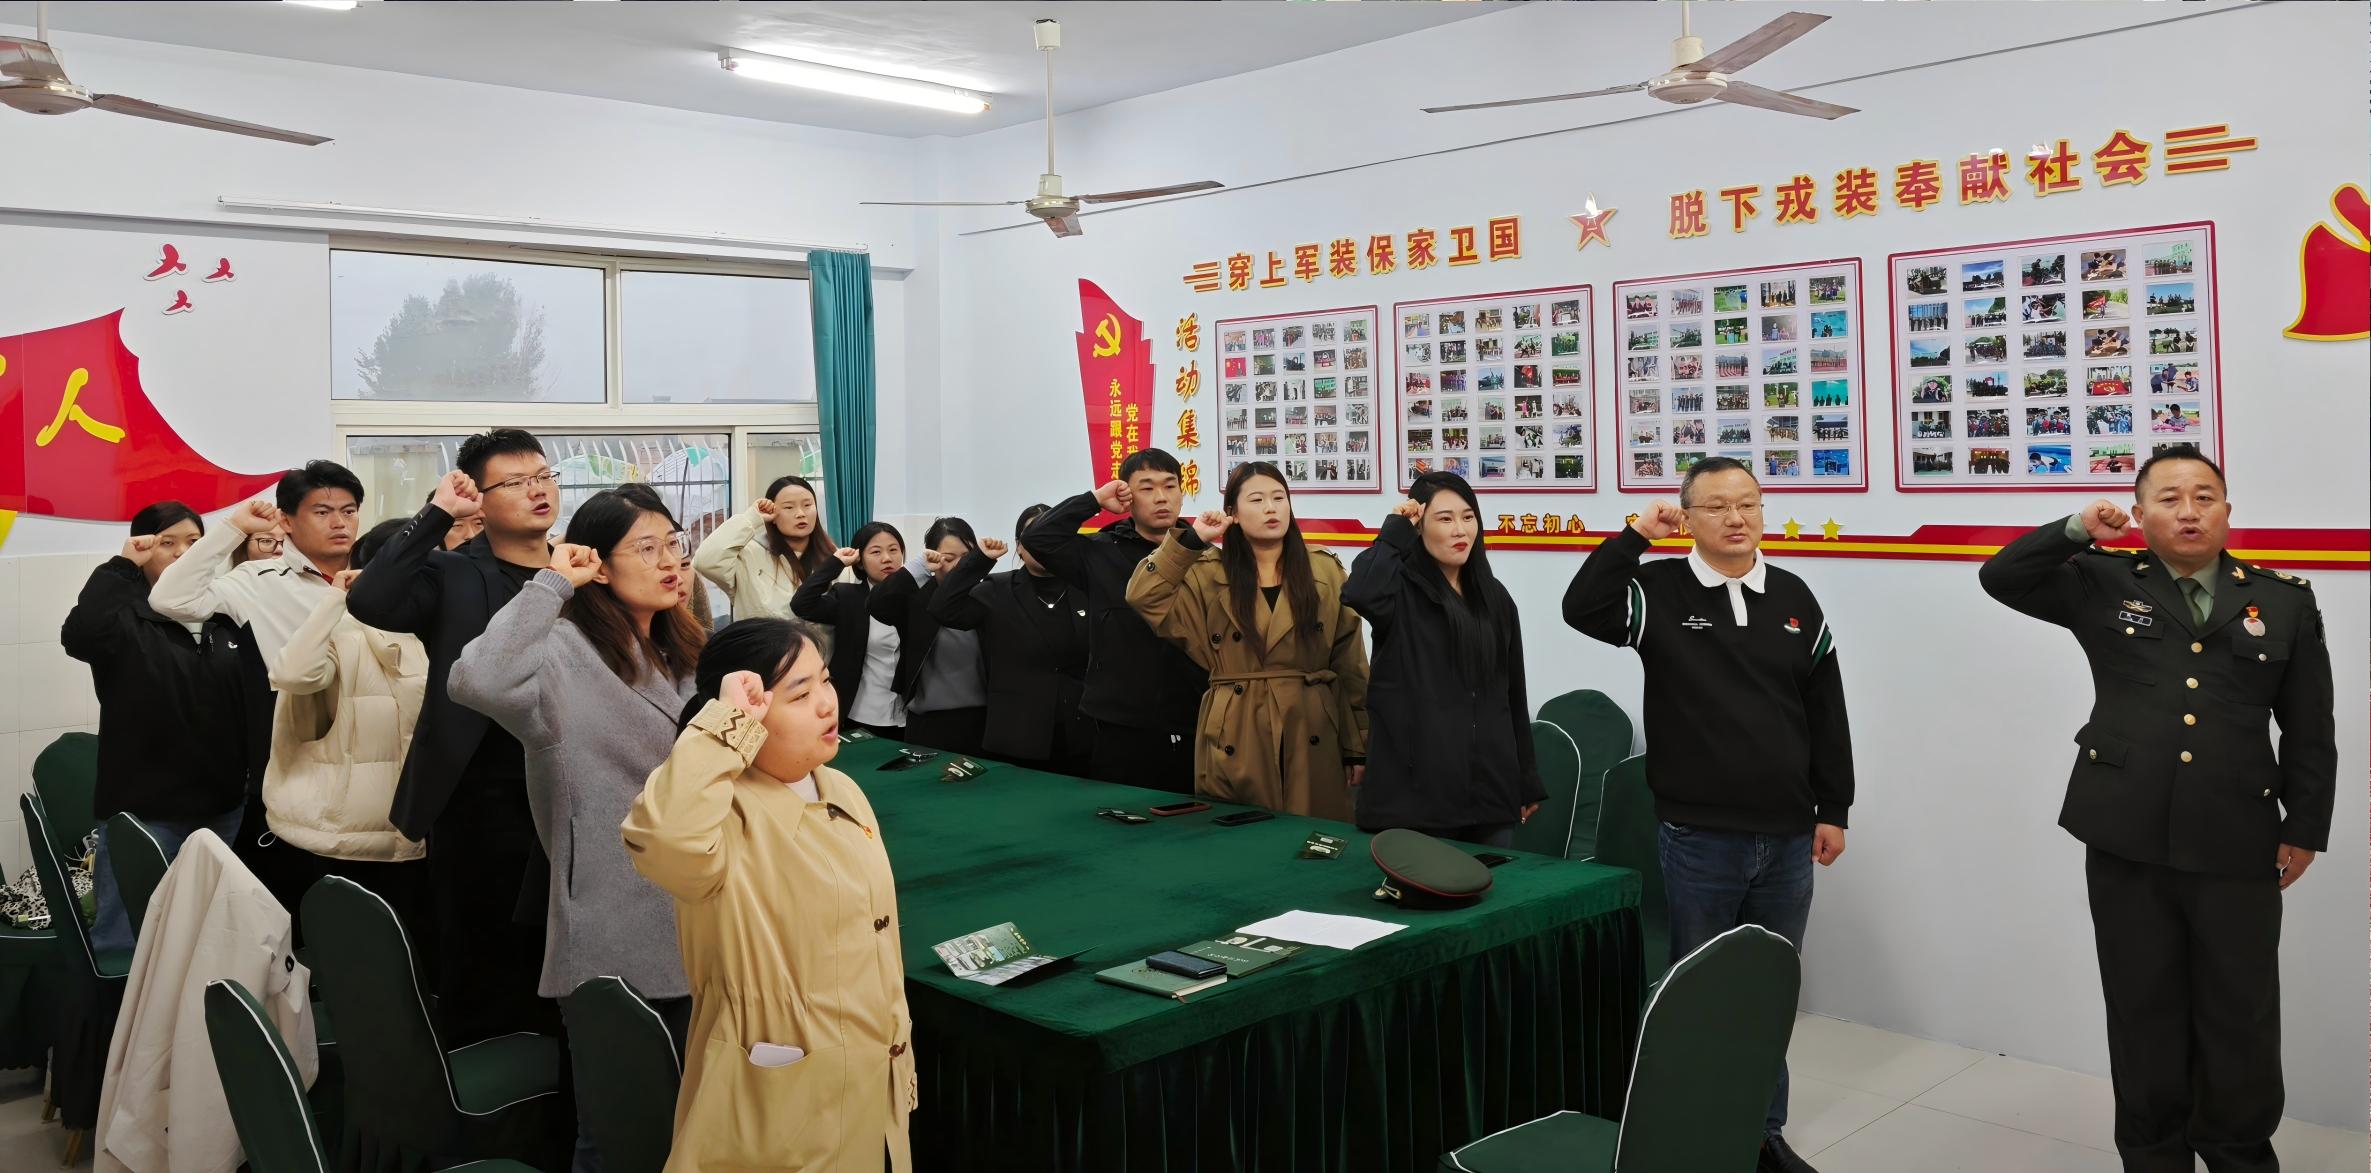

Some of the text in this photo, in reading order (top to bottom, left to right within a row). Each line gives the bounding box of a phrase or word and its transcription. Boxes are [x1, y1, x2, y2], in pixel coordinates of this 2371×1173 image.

[1667, 130, 2152, 238] 脱下戎装奉献社会
[1225, 216, 1522, 290] 穿上军装保家卫国
[0, 353, 126, 447] 人
[1110, 379, 1122, 480] 永远跟党走
[1176, 313, 1200, 499] 活动集锦
[1498, 514, 1585, 534] 不忘初心
